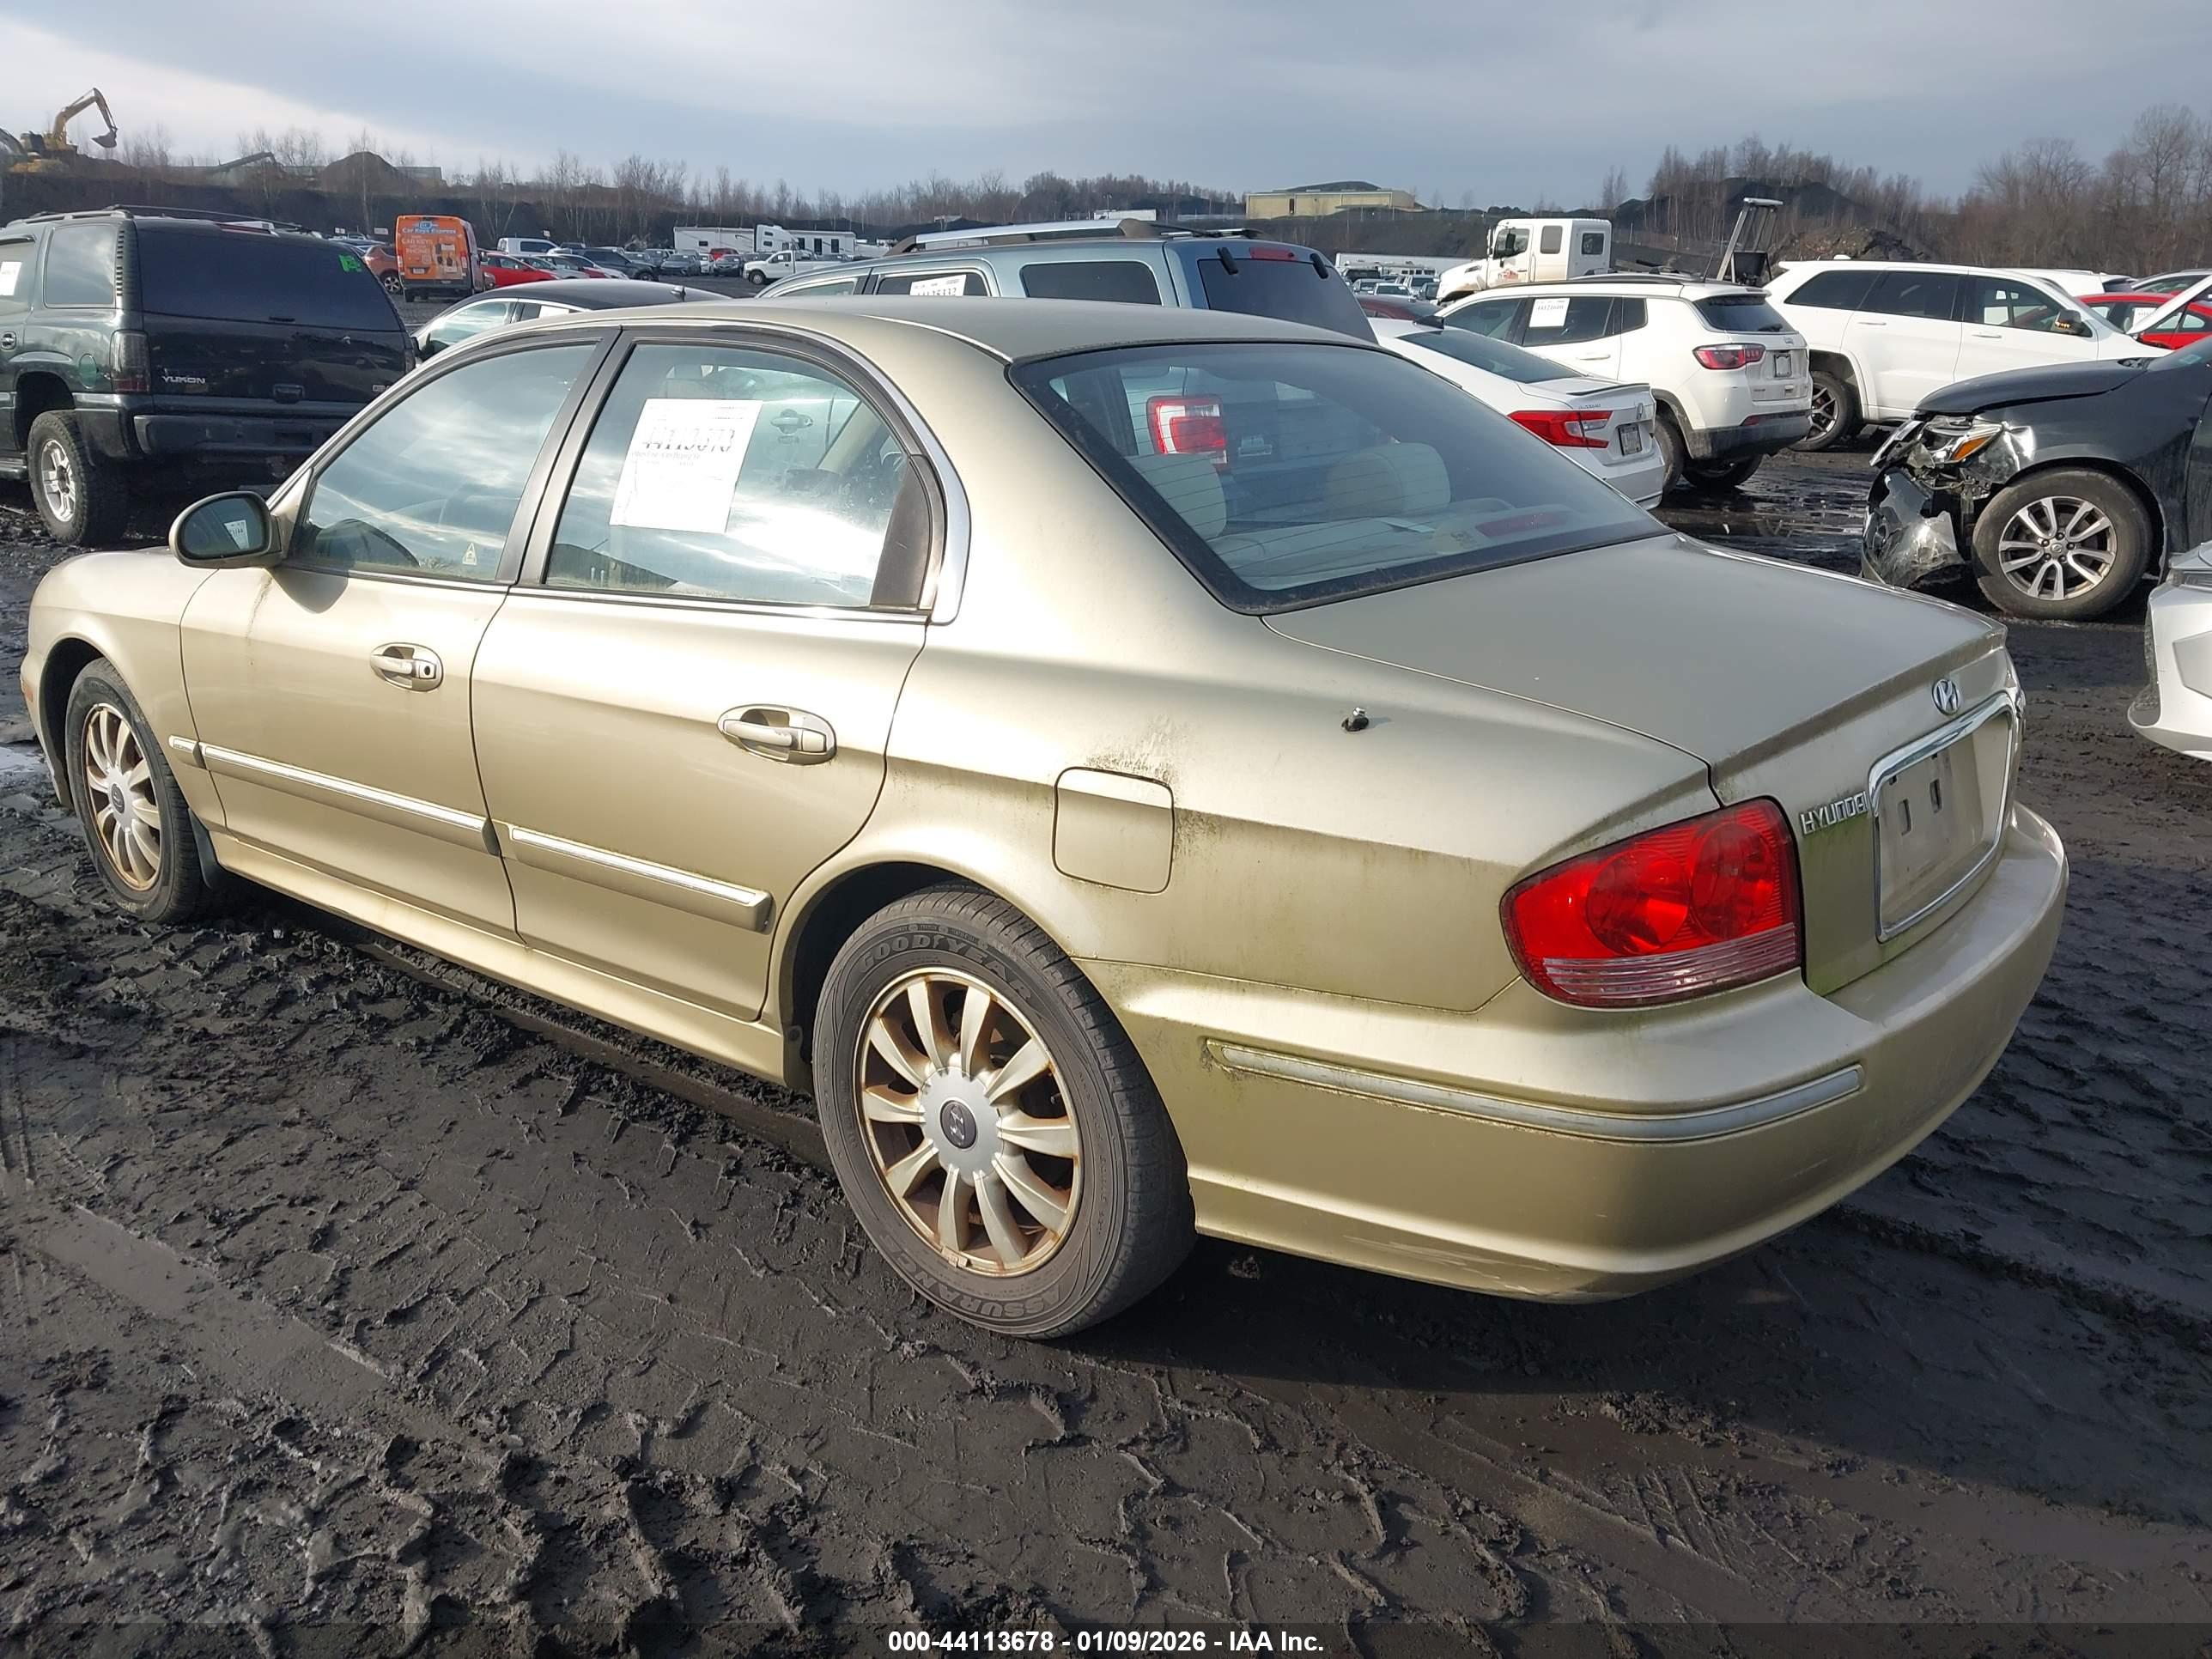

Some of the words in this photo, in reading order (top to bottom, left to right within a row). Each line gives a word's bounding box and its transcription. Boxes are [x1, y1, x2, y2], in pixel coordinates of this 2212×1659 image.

[161, 375, 206, 385] YUKON
[1800, 791, 1868, 835] HYUNDAI
[860, 933, 1032, 1001] GOODYEAR
[878, 1234, 1061, 1318] ASSURANCE
